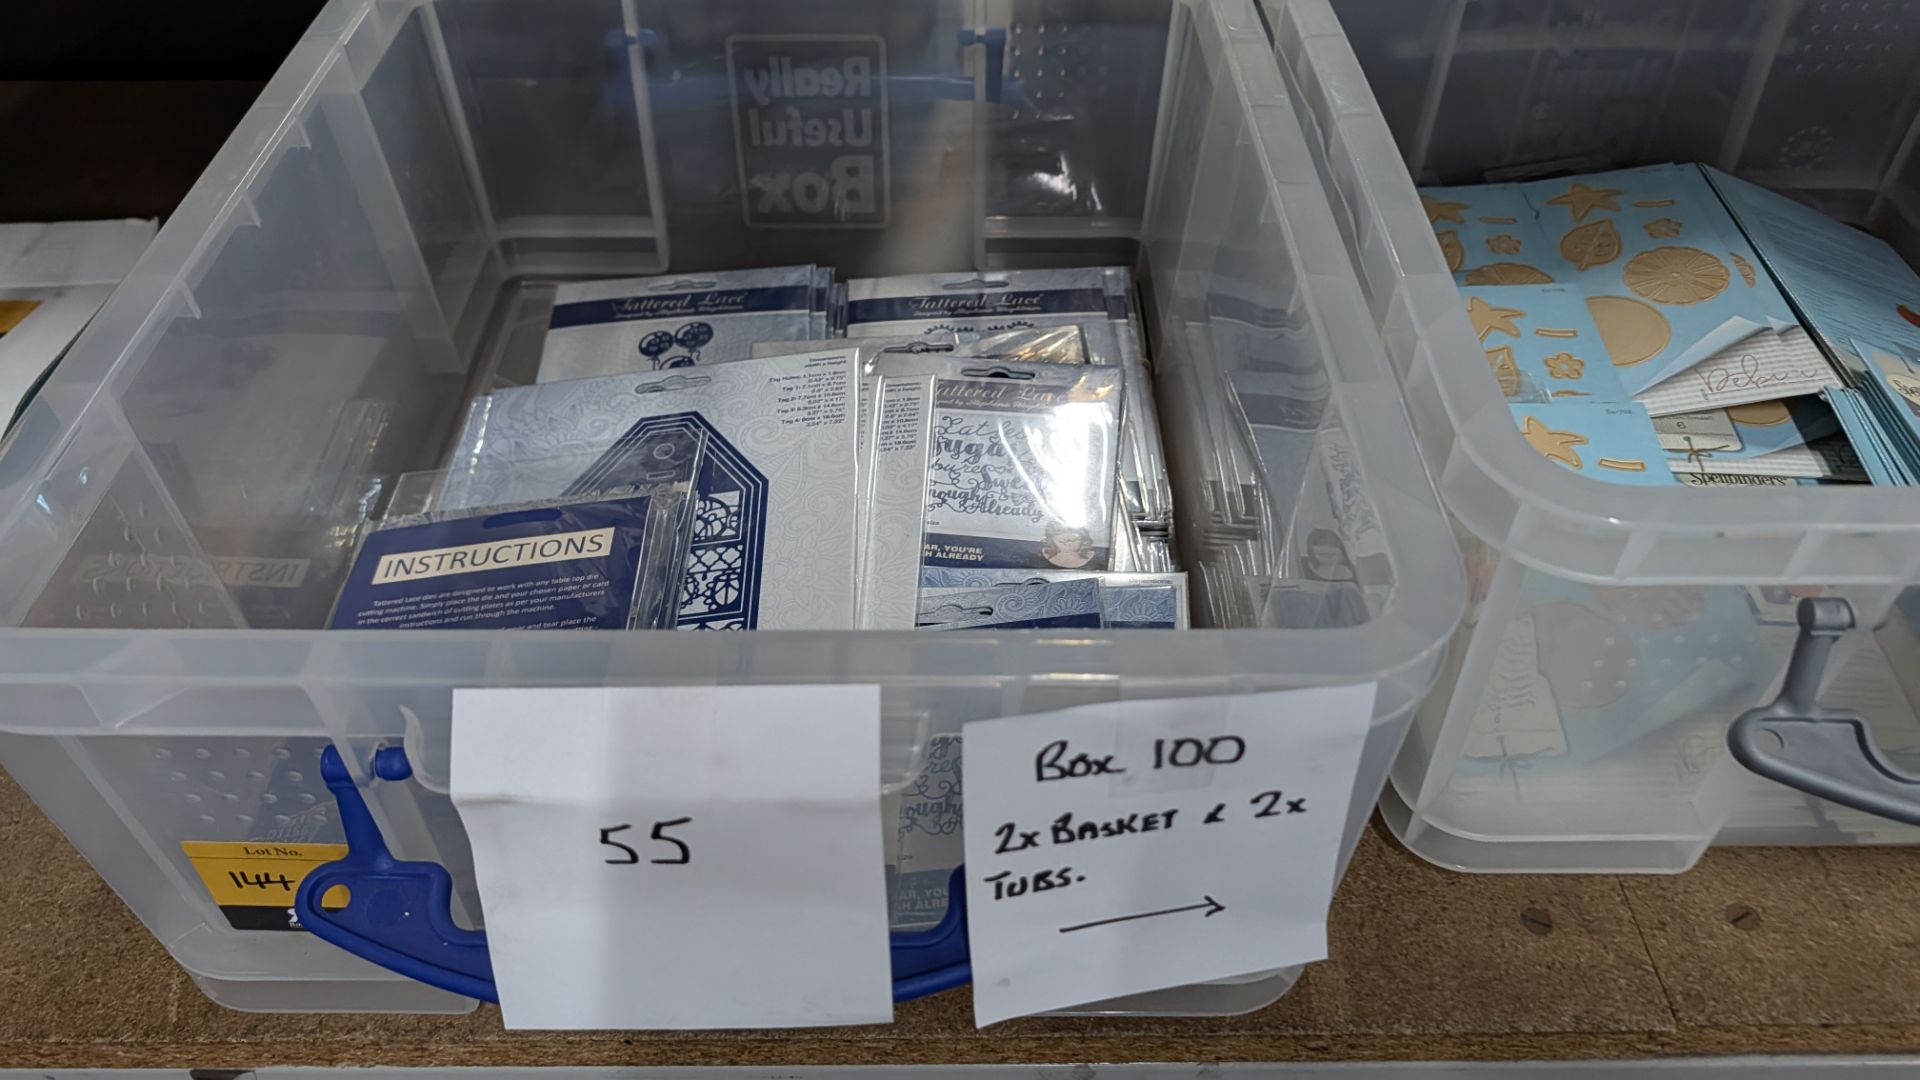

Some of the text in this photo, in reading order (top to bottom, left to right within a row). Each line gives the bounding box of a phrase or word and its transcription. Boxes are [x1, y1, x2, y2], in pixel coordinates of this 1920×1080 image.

[611, 293, 745, 312] Tattered Lace
[910, 293, 1041, 311] Tattered Lace
[384, 534, 602, 578] INSTRUCTIONS
[935, 551, 985, 562] ALREADY
[944, 544, 983, 554] YOU'RE
[1154, 735, 1246, 769] 100
[994, 822, 1040, 854] 2x
[1203, 803, 1226, 825] &
[1250, 791, 1307, 820] 2x
[600, 816, 692, 864] 55
[244, 847, 303, 857] Lot No.
[228, 871, 296, 891] 144
[983, 868, 1087, 900] TUBS.
